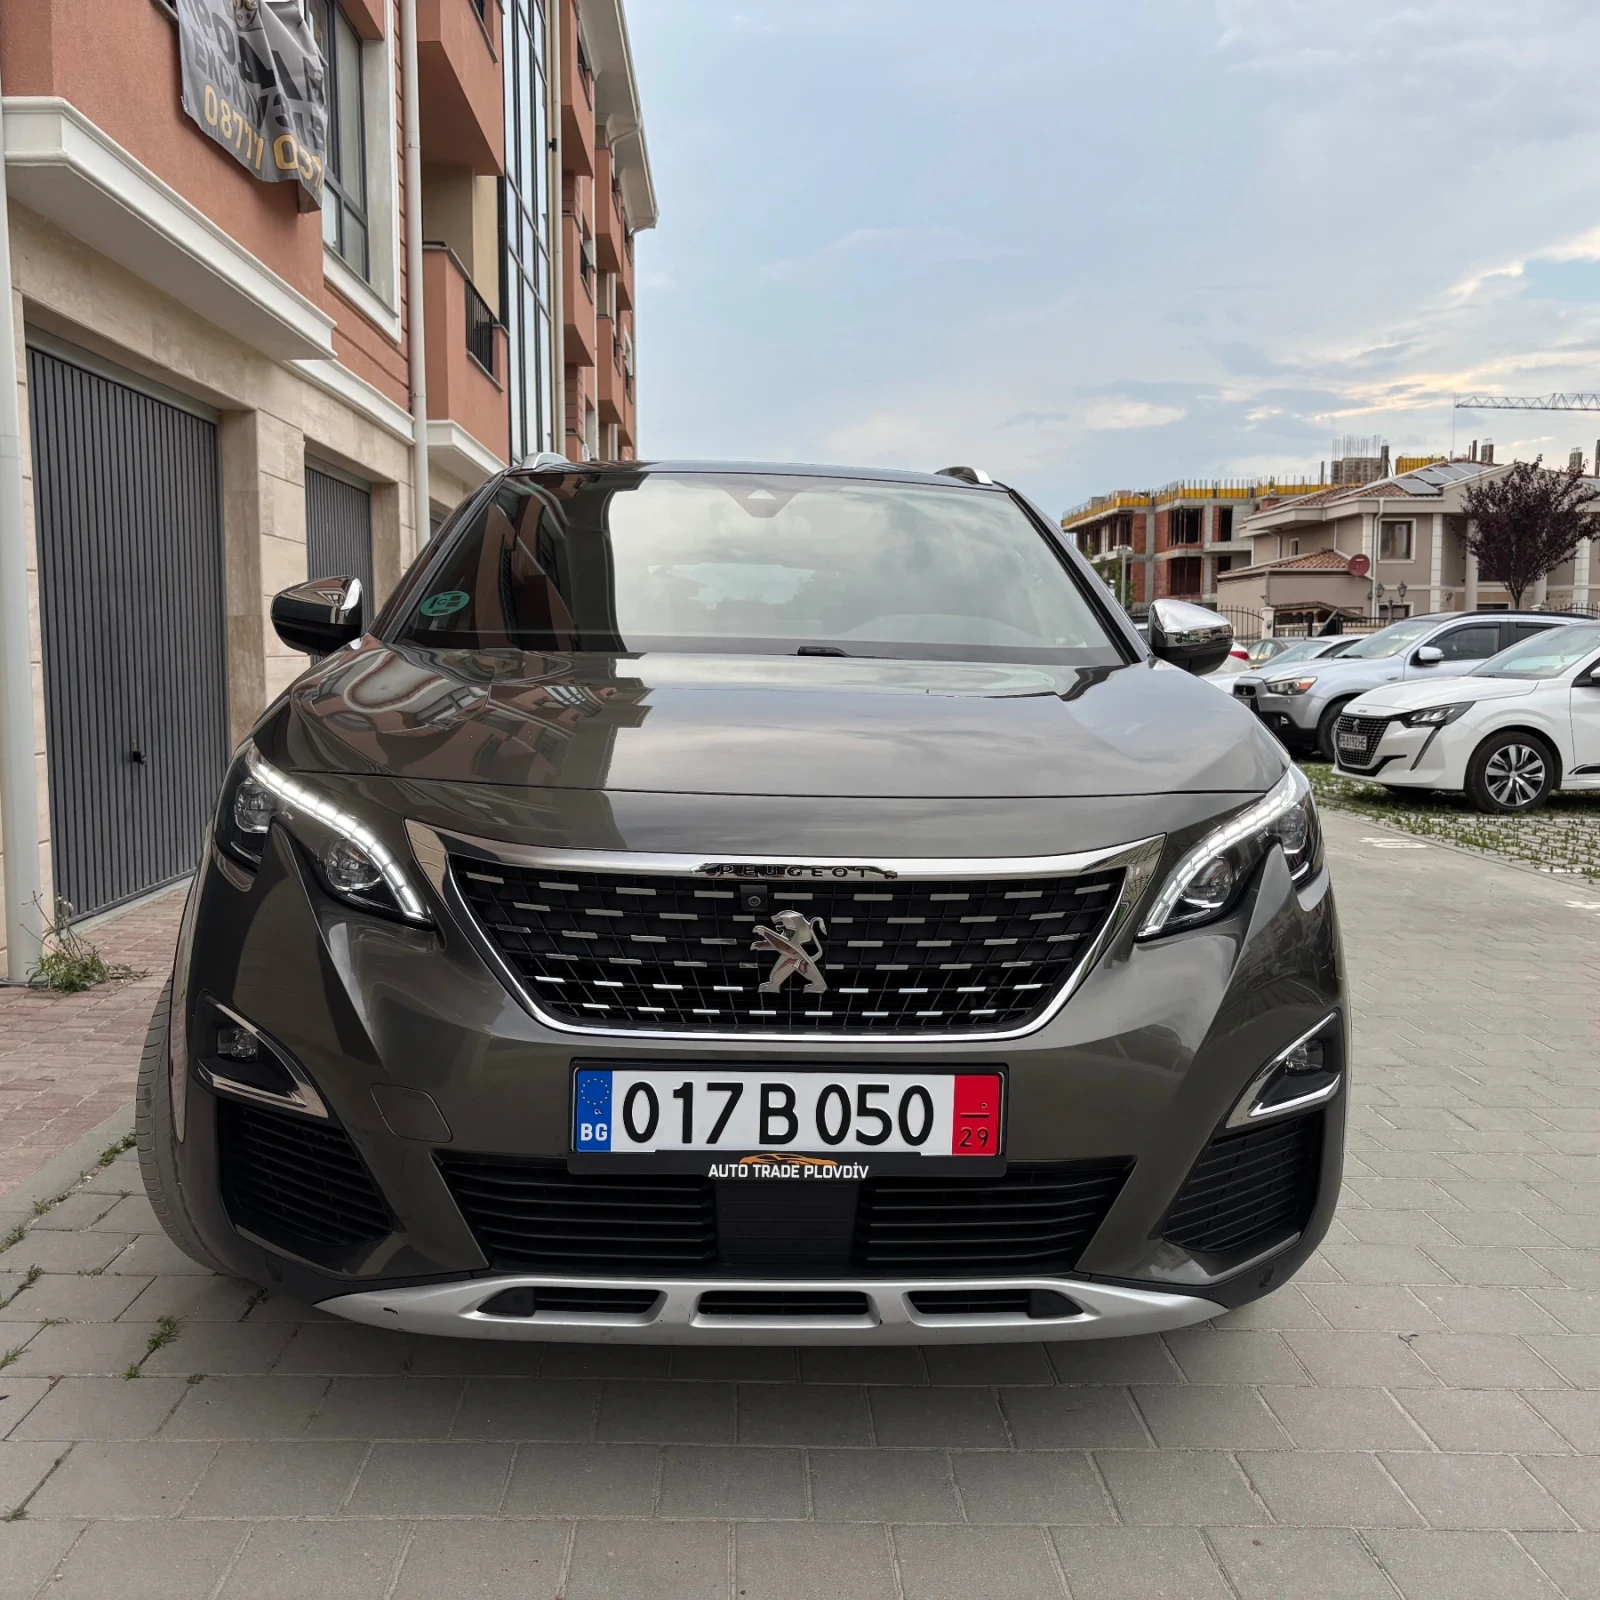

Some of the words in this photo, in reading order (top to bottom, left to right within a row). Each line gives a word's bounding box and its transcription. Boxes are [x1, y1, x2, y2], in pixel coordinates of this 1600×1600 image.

[720, 864, 871, 878] PEUGEOT
[622, 1081, 744, 1144] 017
[758, 1083, 799, 1145] B
[815, 1083, 934, 1146] 050
[580, 1123, 608, 1141] BG
[959, 1127, 989, 1148] 29
[708, 1163, 748, 1178] AUTO
[752, 1164, 800, 1179] TRADE
